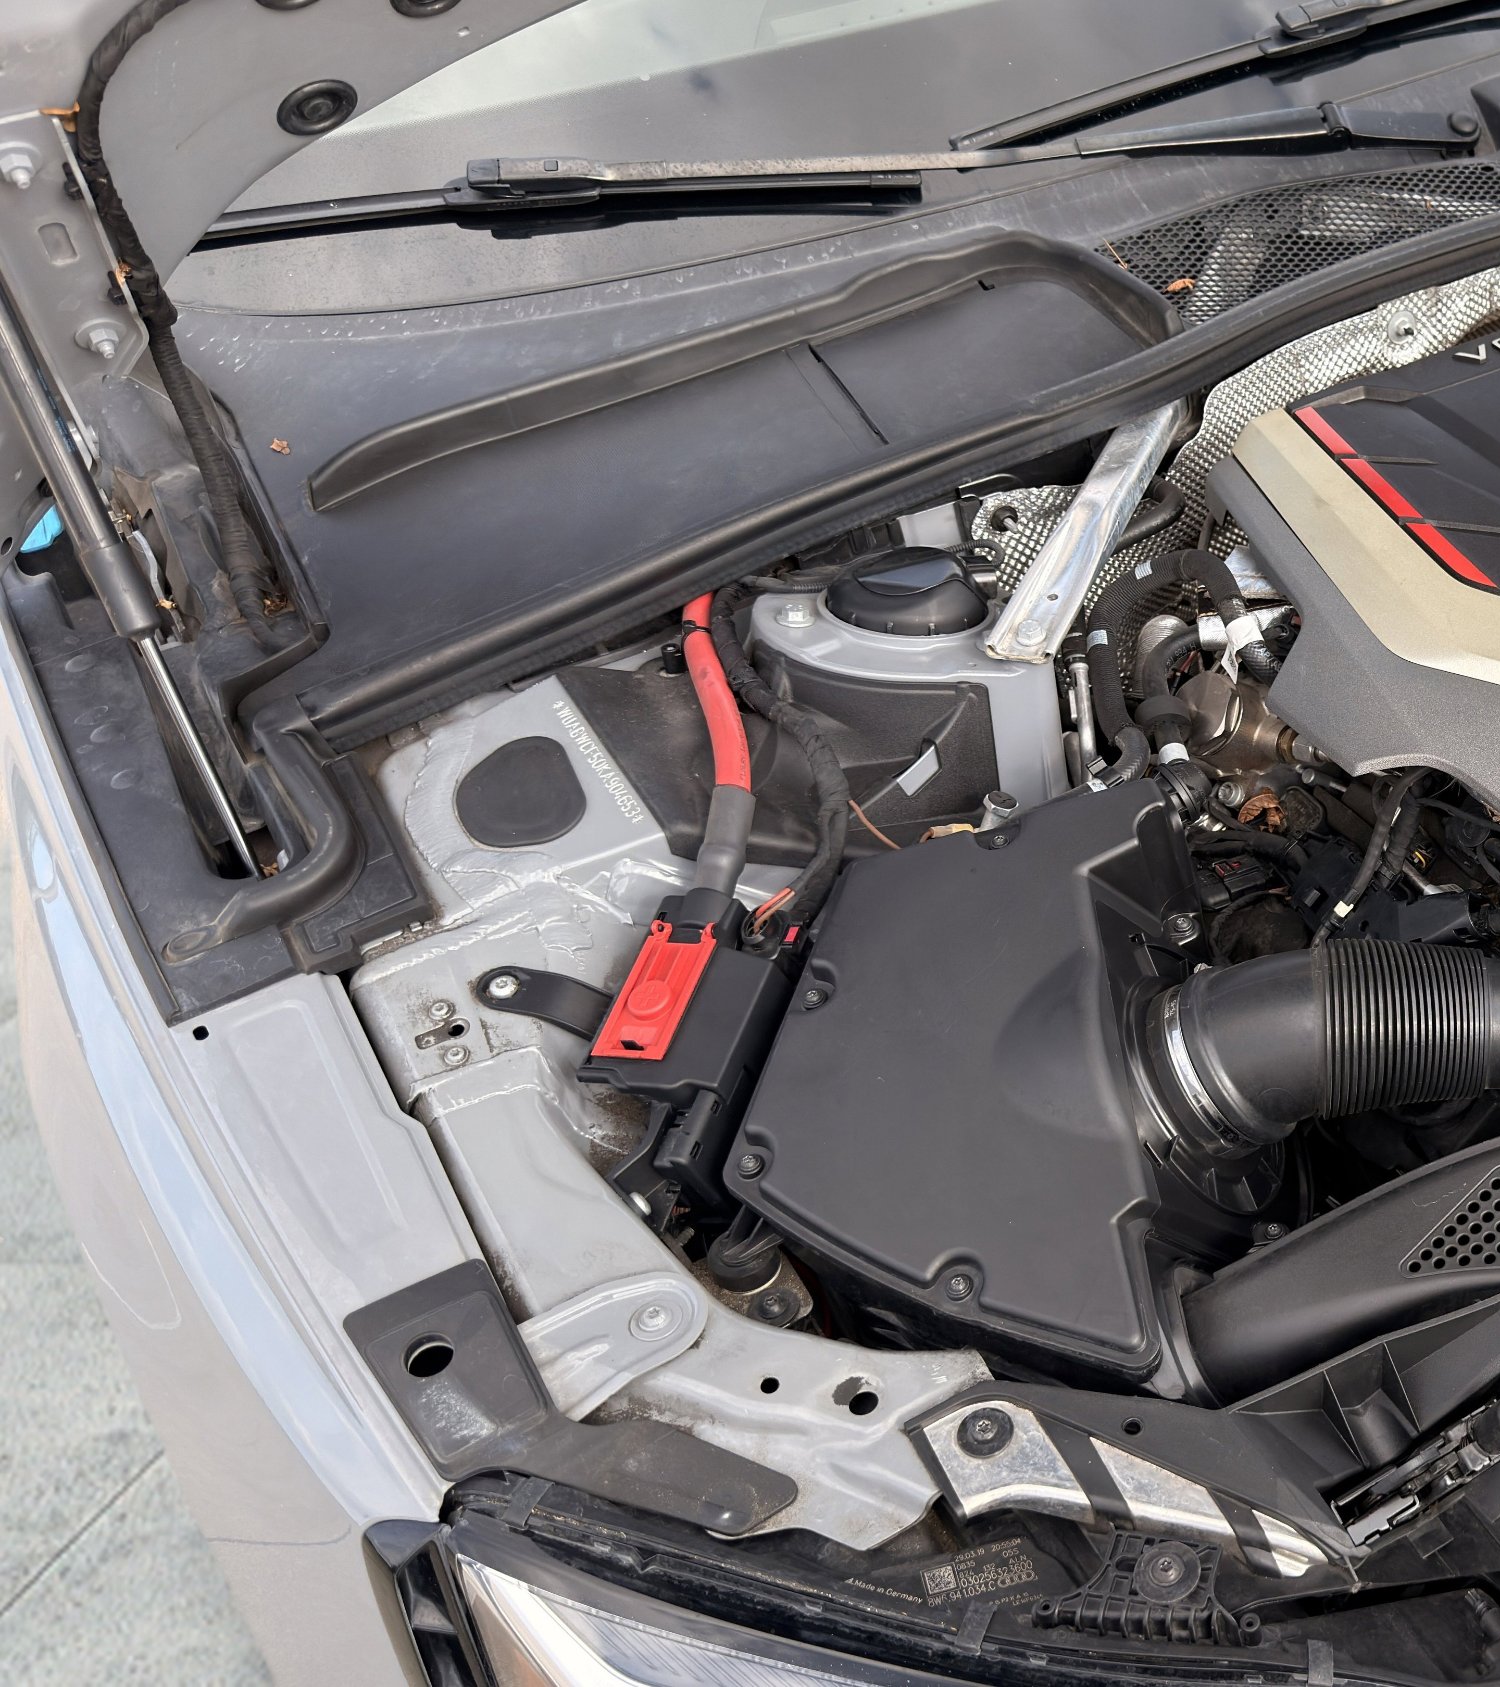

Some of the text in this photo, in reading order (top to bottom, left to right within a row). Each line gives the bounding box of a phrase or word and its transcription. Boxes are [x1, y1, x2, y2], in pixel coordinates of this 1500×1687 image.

[854, 1579, 923, 1604] Made in Germany
